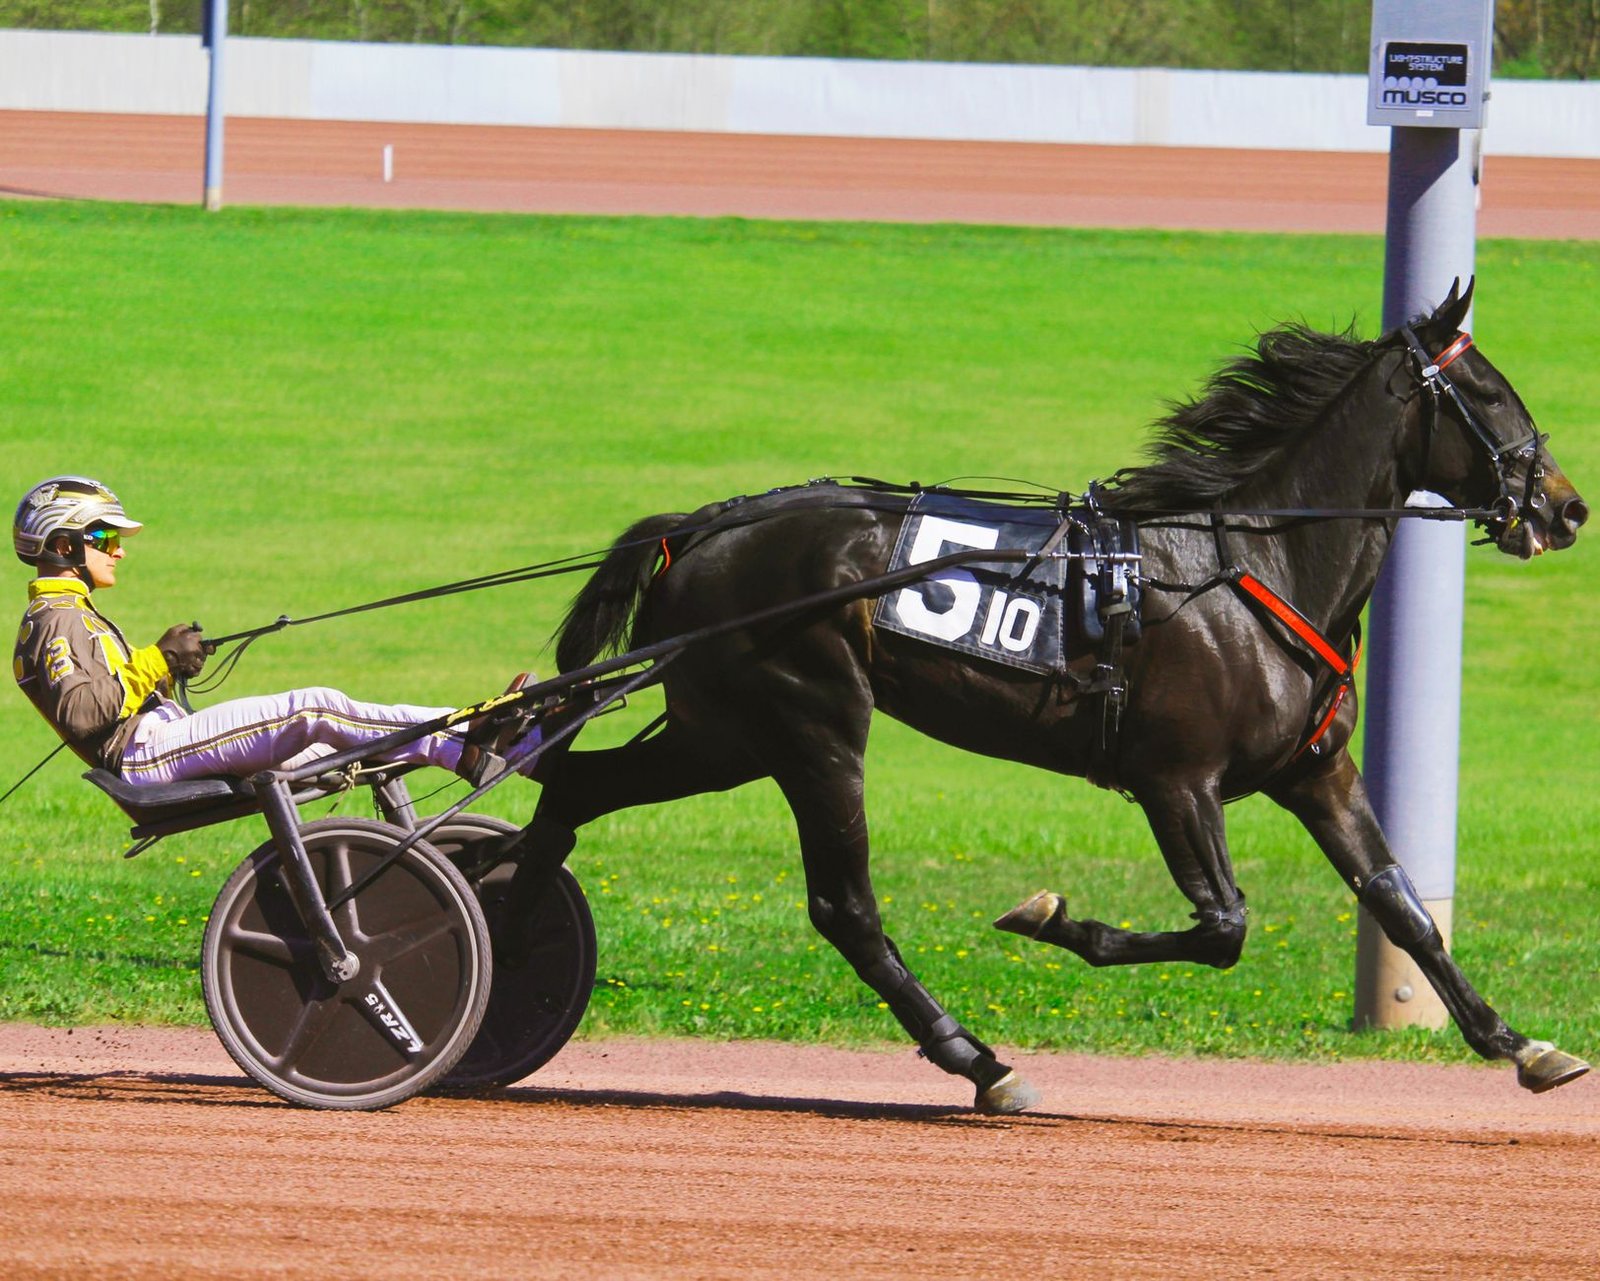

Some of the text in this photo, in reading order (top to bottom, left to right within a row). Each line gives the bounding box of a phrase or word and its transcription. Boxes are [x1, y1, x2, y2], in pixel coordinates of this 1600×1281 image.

[1408, 63, 1444, 71] SYSTEM
[896, 514, 999, 642] 5
[981, 590, 1040, 652] 10
